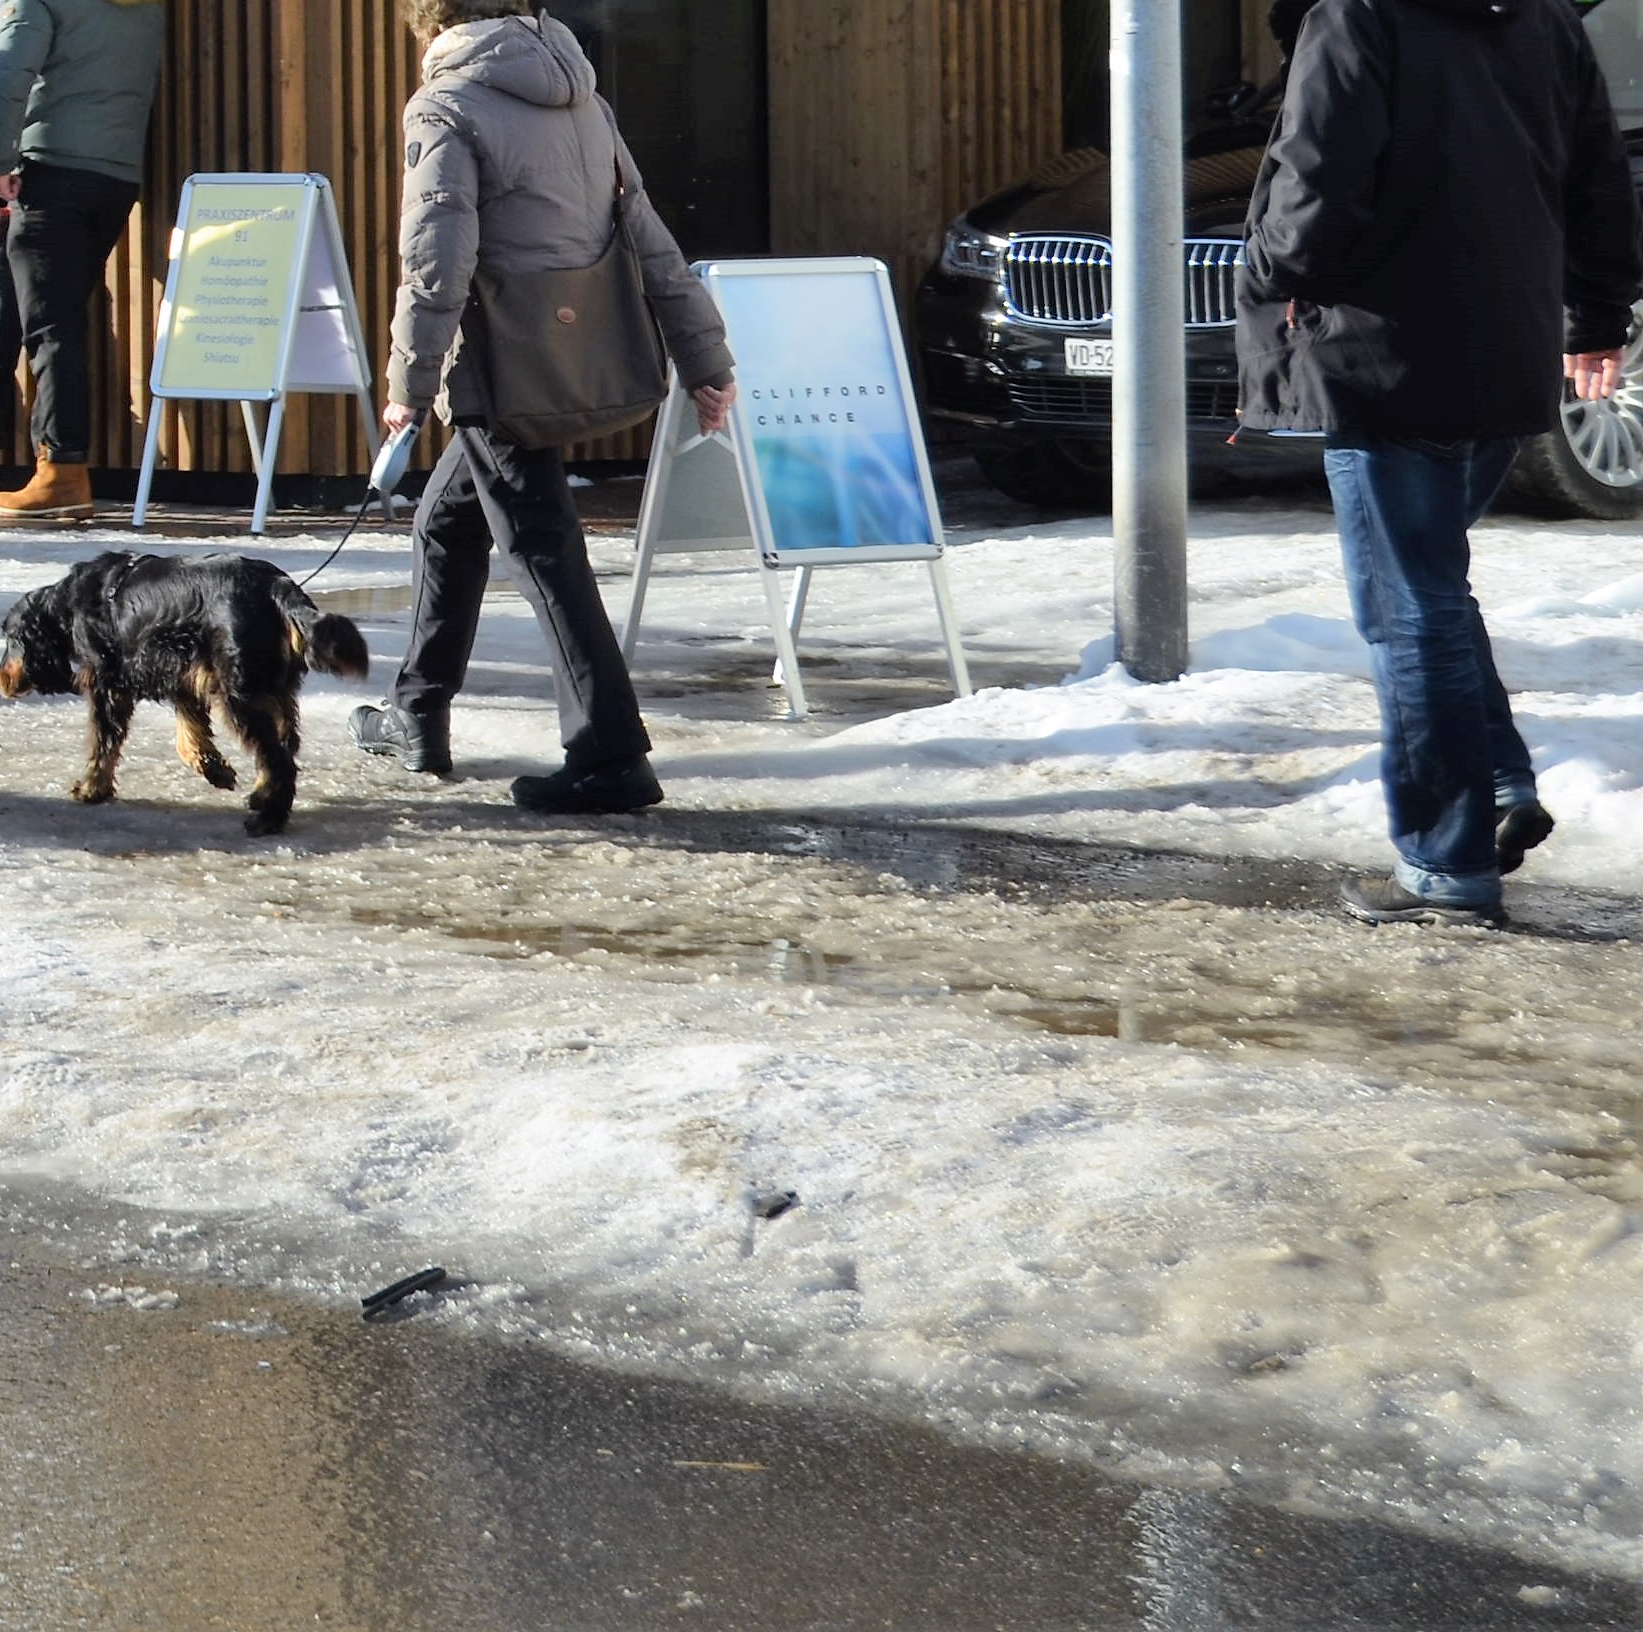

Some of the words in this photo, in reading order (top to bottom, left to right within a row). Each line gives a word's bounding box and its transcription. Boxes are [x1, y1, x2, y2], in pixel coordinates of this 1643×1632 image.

[234, 231, 249, 242] 91
[751, 385, 886, 400] CLIFFORD
[757, 412, 856, 426] CHANCE
